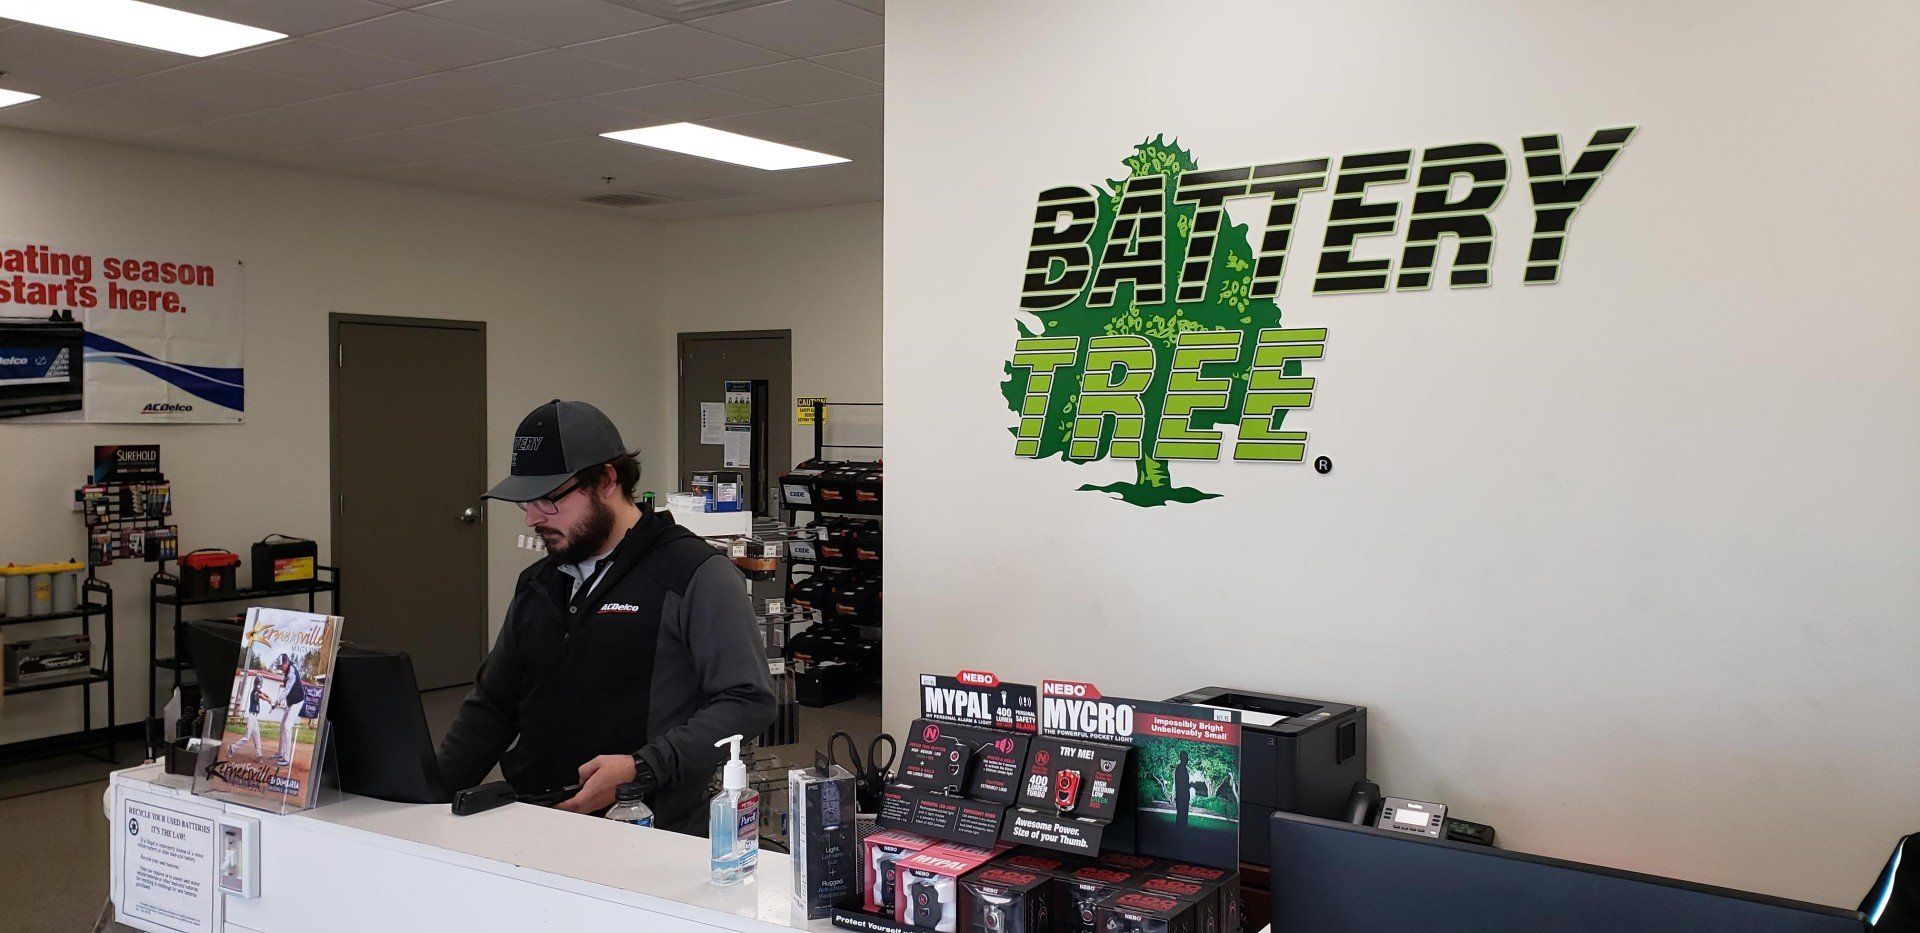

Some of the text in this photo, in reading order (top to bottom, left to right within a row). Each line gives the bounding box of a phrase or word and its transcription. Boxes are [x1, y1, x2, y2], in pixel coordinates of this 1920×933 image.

[1020, 125, 1639, 312] BATTERY
[0, 245, 214, 286] ating season
[0, 275, 186, 313] starts here.
[1012, 327, 1329, 463] TREE
[143, 403, 193, 412] ACDelco
[116, 449, 157, 462] SUREHOLD
[600, 603, 640, 613] ACDelco
[962, 672, 993, 684] NEBO
[1044, 682, 1087, 696] NEBO
[924, 686, 992, 720] MYPAL
[996, 707, 1012, 717] 400
[1015, 709, 1036, 717] PERSONAL
[1043, 697, 1134, 737] MYCRO
[995, 716, 1013, 724] LUMEN
[1015, 715, 1036, 724] SAFETY
[1015, 722, 1037, 731] ALARM
[1153, 717, 1224, 733] Impossibly Bright
[1056, 729, 1089, 738] POWERFUL
[1089, 733, 1114, 742] POCKET
[1114, 735, 1133, 743] LIGHT
[1151, 724, 1228, 740] Unbelievably Small
[1060, 746, 1095, 760] TRY ME!
[1029, 774, 1049, 786] 400
[1026, 789, 1046, 799] TURBO
[1027, 782, 1048, 793] LUMEN
[1092, 785, 1115, 795] MEDIUM
[128, 806, 211, 834] RECYCLE YOUR USED BATTERIES
[740, 811, 756, 826] Purell
[151, 825, 186, 841] IT'S THE LAW!
[1014, 816, 1053, 831] Awesome
[1053, 823, 1080, 836] Power.
[1013, 827, 1088, 848] Size of your Thumb.
[910, 854, 968, 871] MYPAL
[982, 886, 998, 894] NEBO
[836, 915, 902, 933] Protect Yourself
[1125, 913, 1142, 921] NEBO
